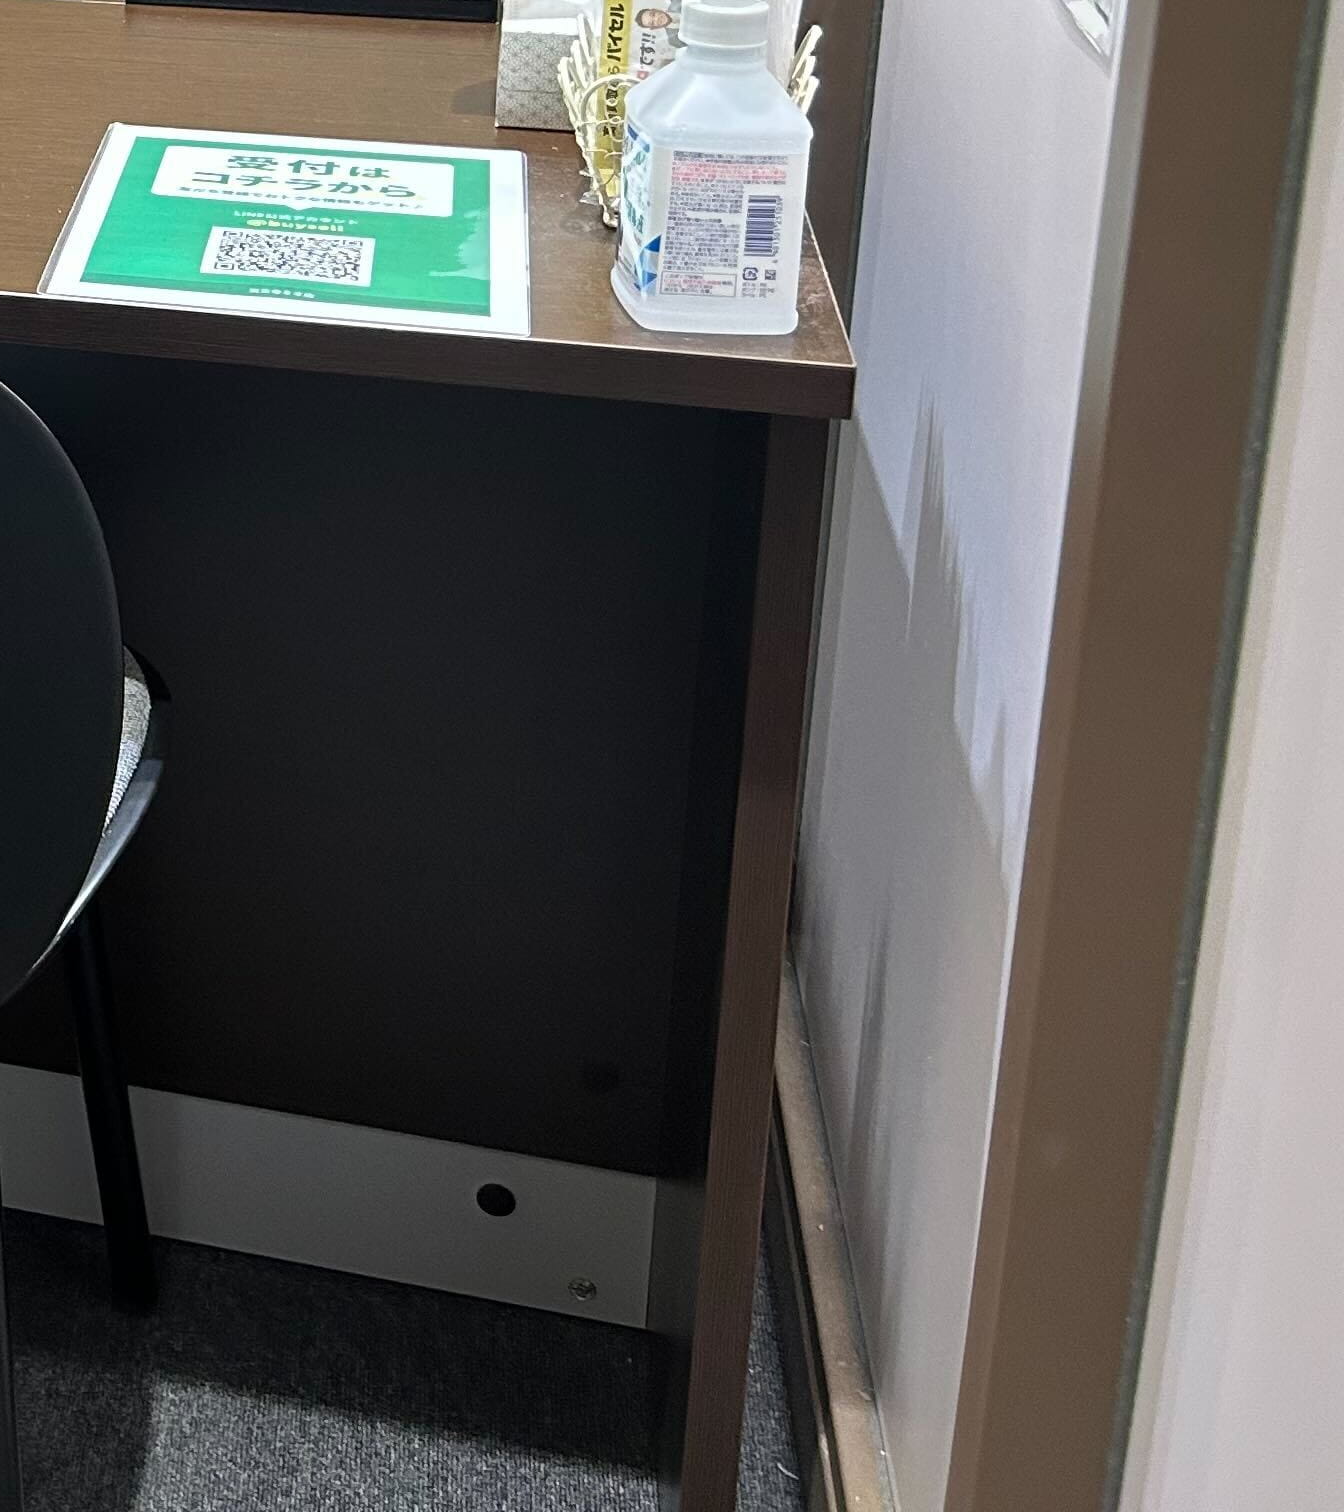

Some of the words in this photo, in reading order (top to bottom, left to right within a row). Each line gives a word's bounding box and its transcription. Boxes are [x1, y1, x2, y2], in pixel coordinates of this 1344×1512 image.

[227, 154, 393, 181] 受付は
[192, 170, 417, 200] コチラから
[245, 218, 345, 232] @buysell
